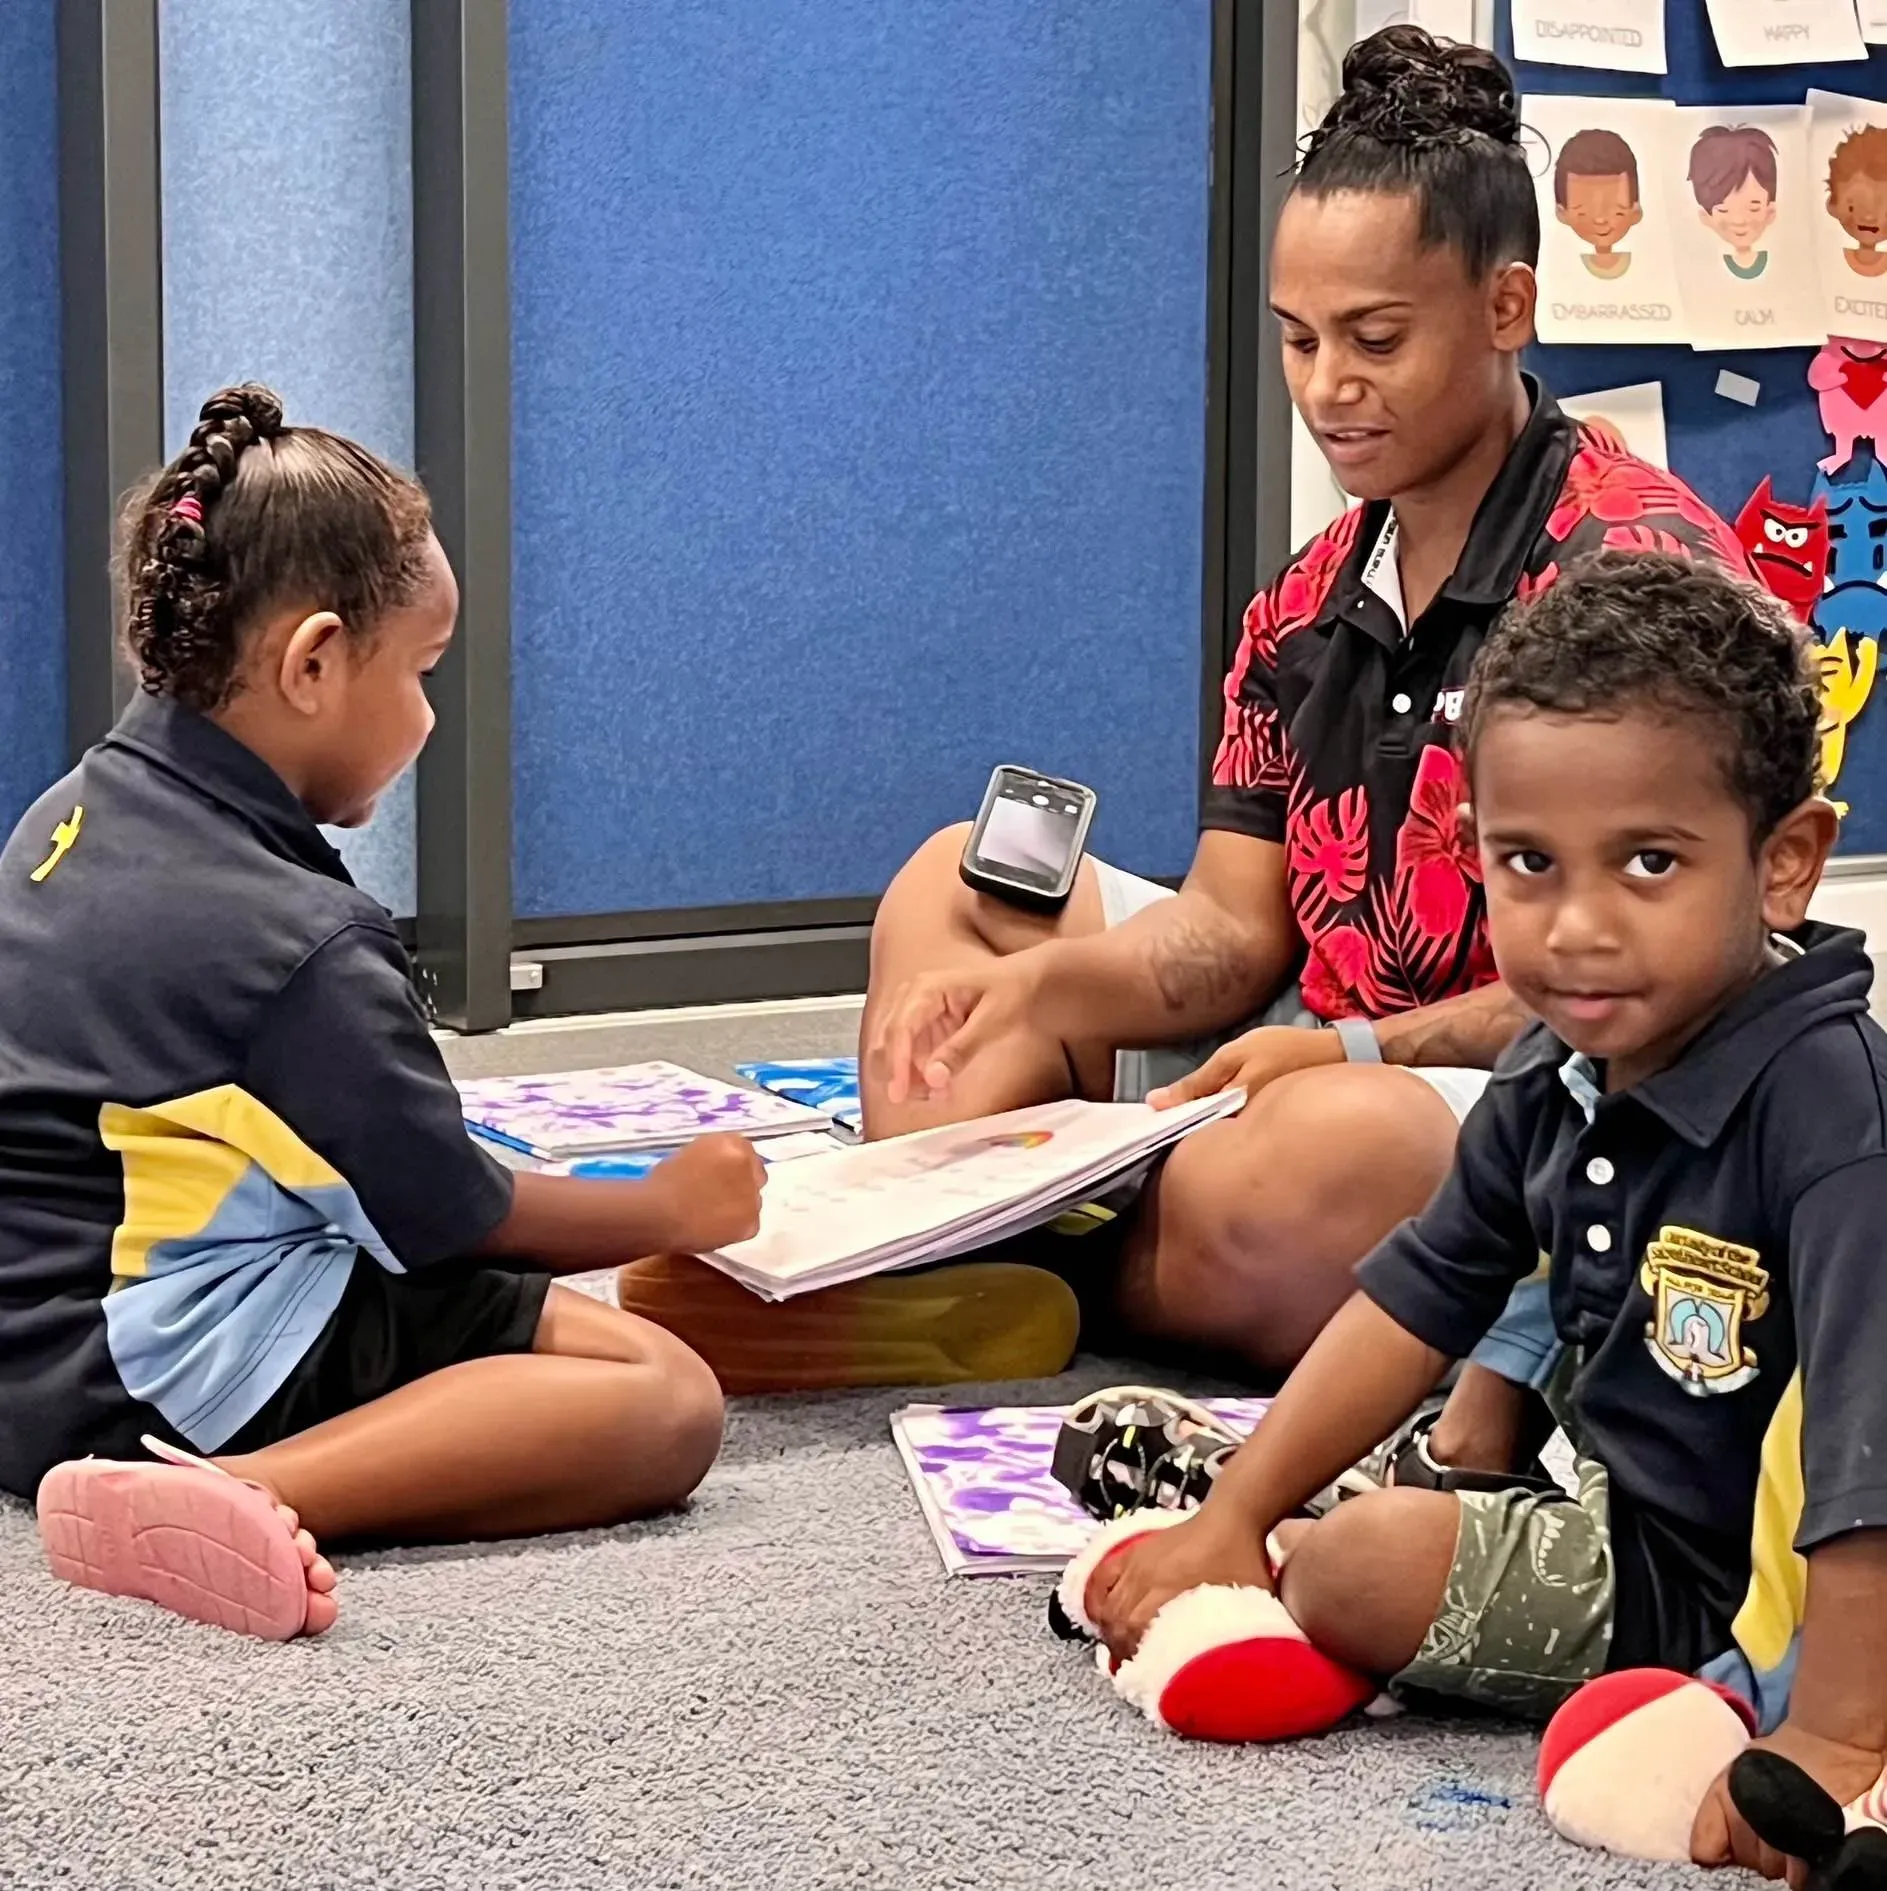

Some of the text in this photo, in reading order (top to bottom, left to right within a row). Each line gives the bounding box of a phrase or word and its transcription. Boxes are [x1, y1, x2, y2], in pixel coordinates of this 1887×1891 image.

[1534, 19, 1643, 48] DISAPPOINTED
[1763, 24, 1812, 42] HAPPY
[1551, 302, 1673, 323] EMBARRASSED
[1734, 308, 1776, 327] CALM
